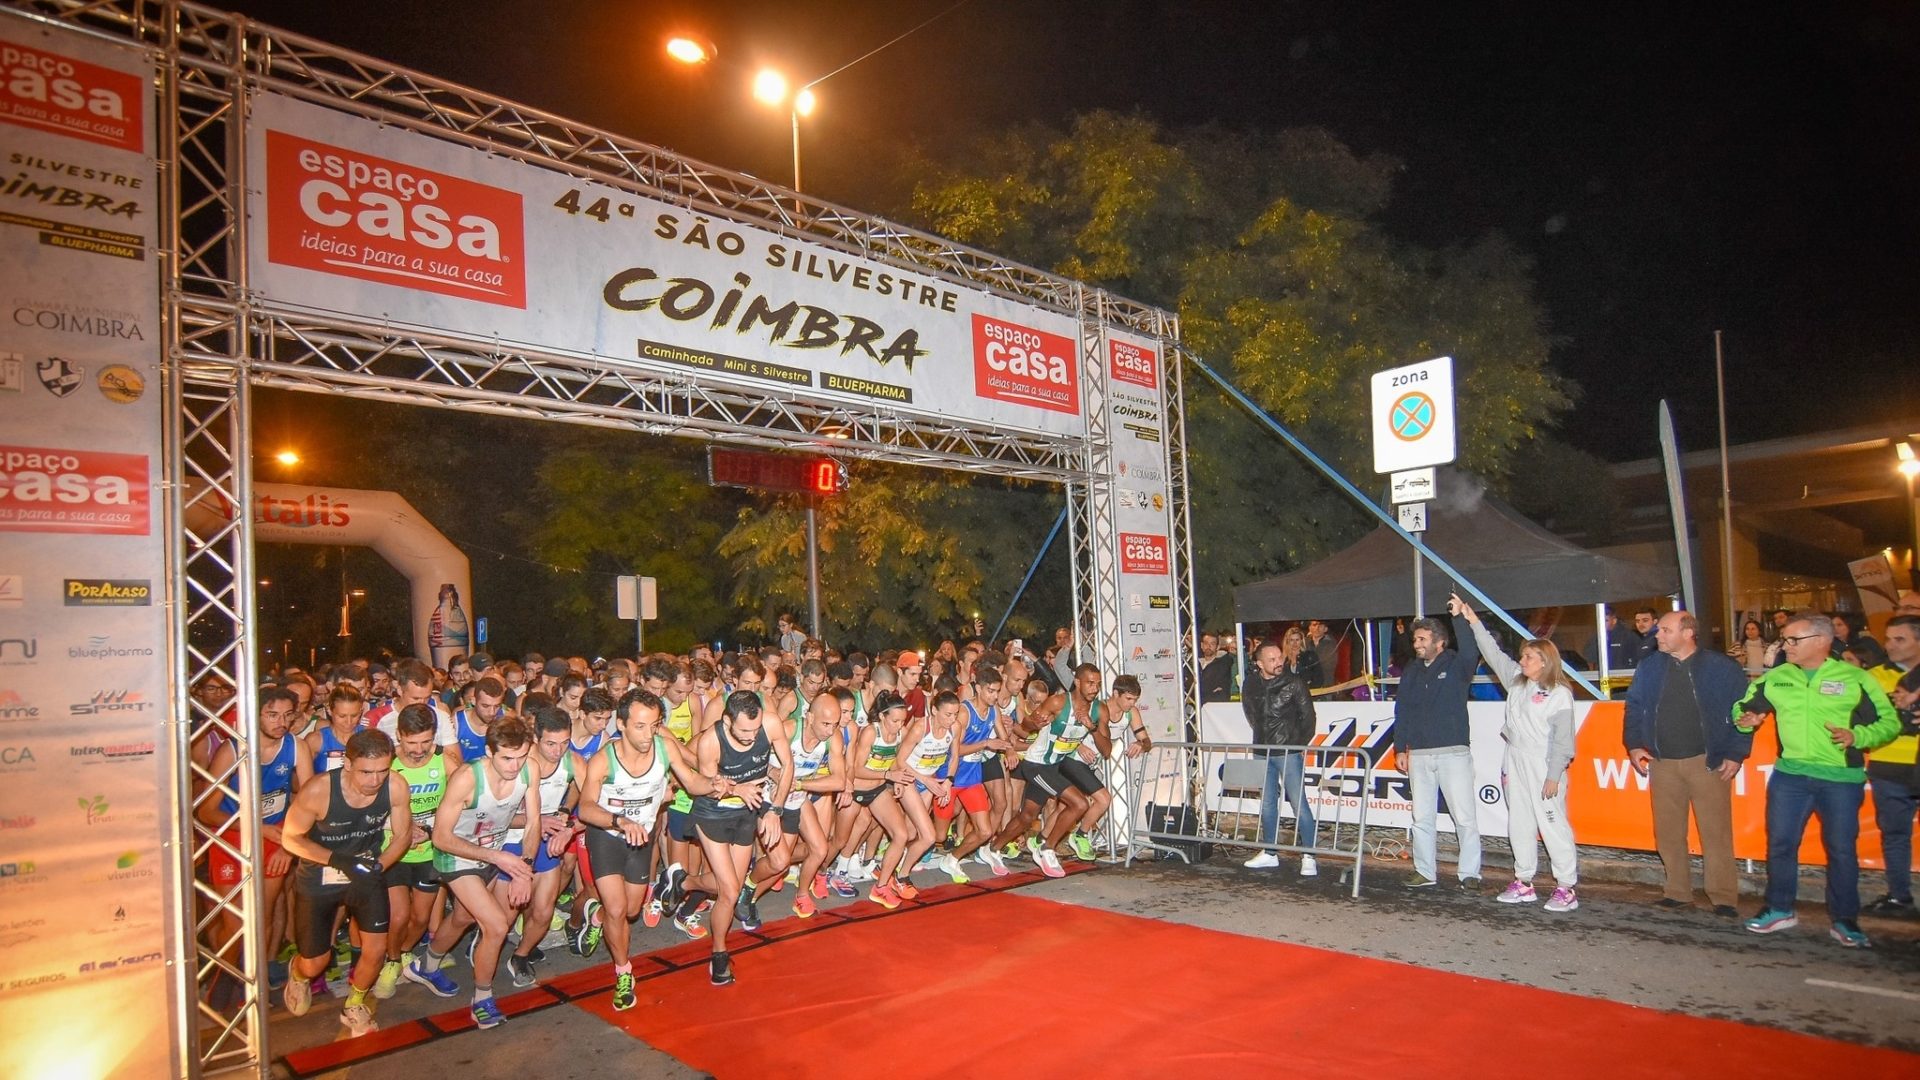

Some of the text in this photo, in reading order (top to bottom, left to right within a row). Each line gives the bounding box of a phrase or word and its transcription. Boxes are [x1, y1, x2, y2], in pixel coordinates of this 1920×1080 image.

[0, 65, 123, 121] asa
[93, 122, 125, 137] casa
[10, 153, 143, 189] SILVESTRE
[299, 149, 440, 202] espaço
[300, 179, 502, 262] casa
[50, 235, 136, 258] BLUEPHARMA
[300, 229, 503, 287] ideias para a sua casa
[654, 213, 746, 256] SÃO
[765, 243, 959, 314] SILVESTRE
[13, 307, 145, 341] COIMBRA
[984, 322, 1041, 351] espaço
[643, 343, 808, 383] Caminhada Mini S. Silvestre
[985, 341, 1069, 386] casa
[1114, 342, 1140, 358] espaço
[1115, 350, 1152, 375] casa
[828, 375, 907, 400] BLUEPHARMA
[987, 373, 1070, 402] ideias para a sua casa
[1392, 370, 1429, 387] zona
[17, 509, 52, 522] para
[56, 511, 66, 521] a
[70, 509, 96, 521] sua
[99, 511, 132, 523] casa
[1125, 535, 1151, 545] espaço
[1126, 544, 1164, 561] casa
[69, 646, 153, 660] bluepharma
